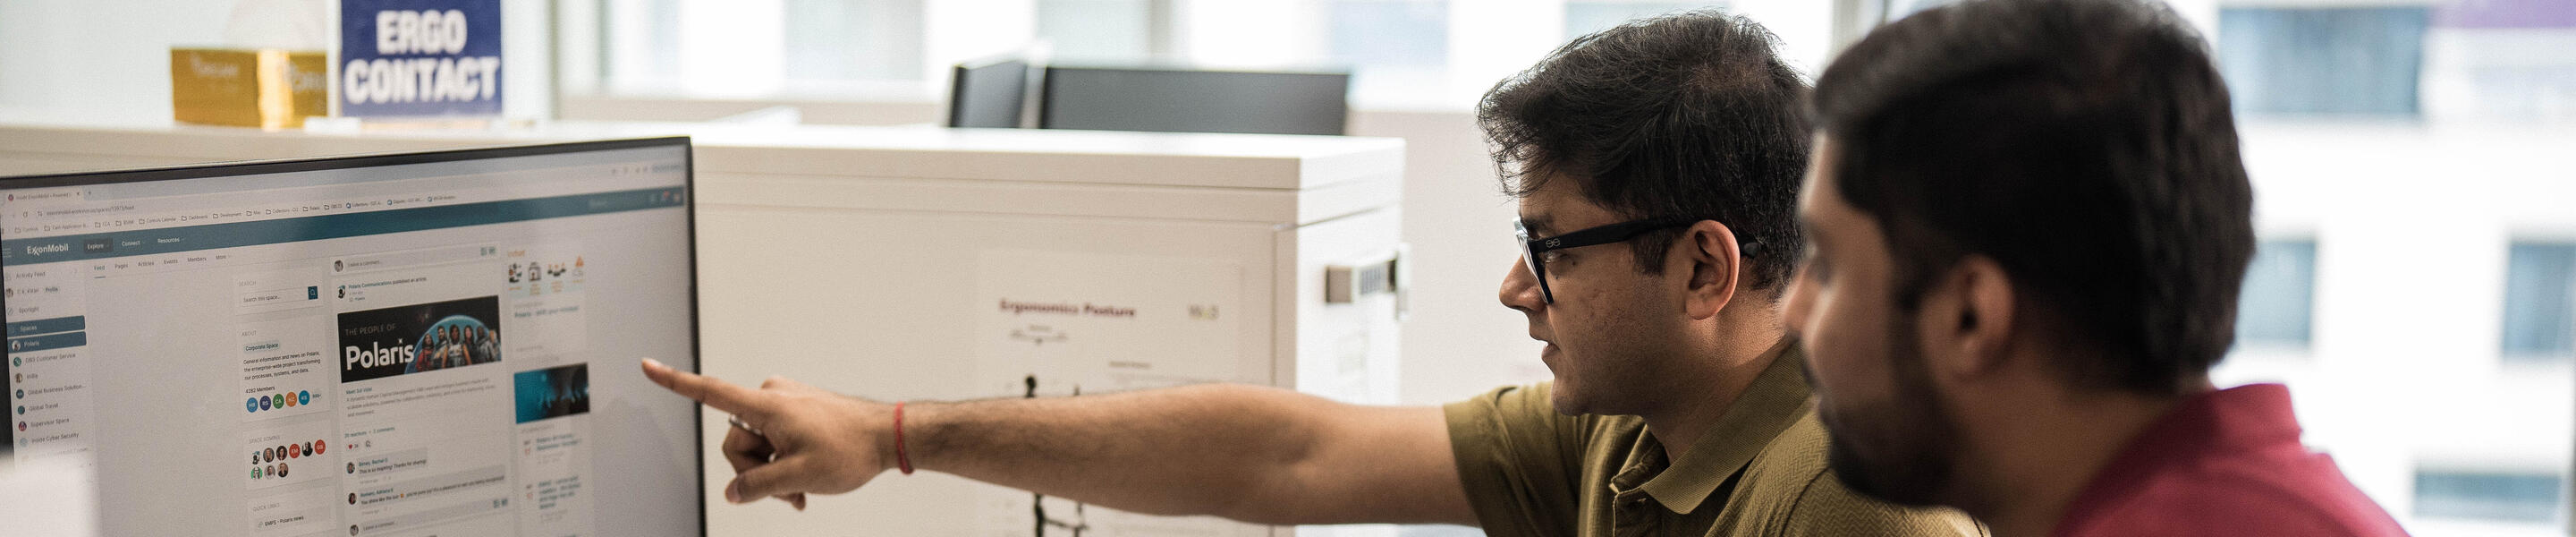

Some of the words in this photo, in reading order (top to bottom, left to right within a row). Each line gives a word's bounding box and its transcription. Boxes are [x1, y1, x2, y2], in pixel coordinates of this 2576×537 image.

[376, 9, 467, 55] ERGO
[345, 56, 500, 104] CONTACT
[122, 240, 140, 248] Connect
[157, 236, 180, 244] Resources
[27, 243, 68, 256] ExxonMobil
[87, 243, 104, 251] Explore
[187, 255, 207, 263] Members
[114, 262, 128, 270] Pages
[361, 280, 392, 288] Communications
[999, 300, 1079, 315] Ergonomics
[1084, 303, 1136, 318] Posture
[345, 328, 358, 336] THE
[360, 324, 385, 335] PEOPLE
[386, 322, 397, 331] OF
[245, 344, 266, 352] Corporate
[267, 342, 279, 350] Space
[36, 354, 57, 362] Customer
[243, 357, 258, 365] General
[259, 354, 281, 362] information
[345, 338, 414, 371] Polaris
[283, 361, 296, 369] project
[297, 358, 321, 367] transforming
[257, 385, 275, 393] Members
[29, 404, 45, 412] Global
[30, 420, 55, 428] Supervisor
[55, 417, 69, 425] Space
[47, 434, 60, 442] Cyber
[61, 431, 79, 440] Security
